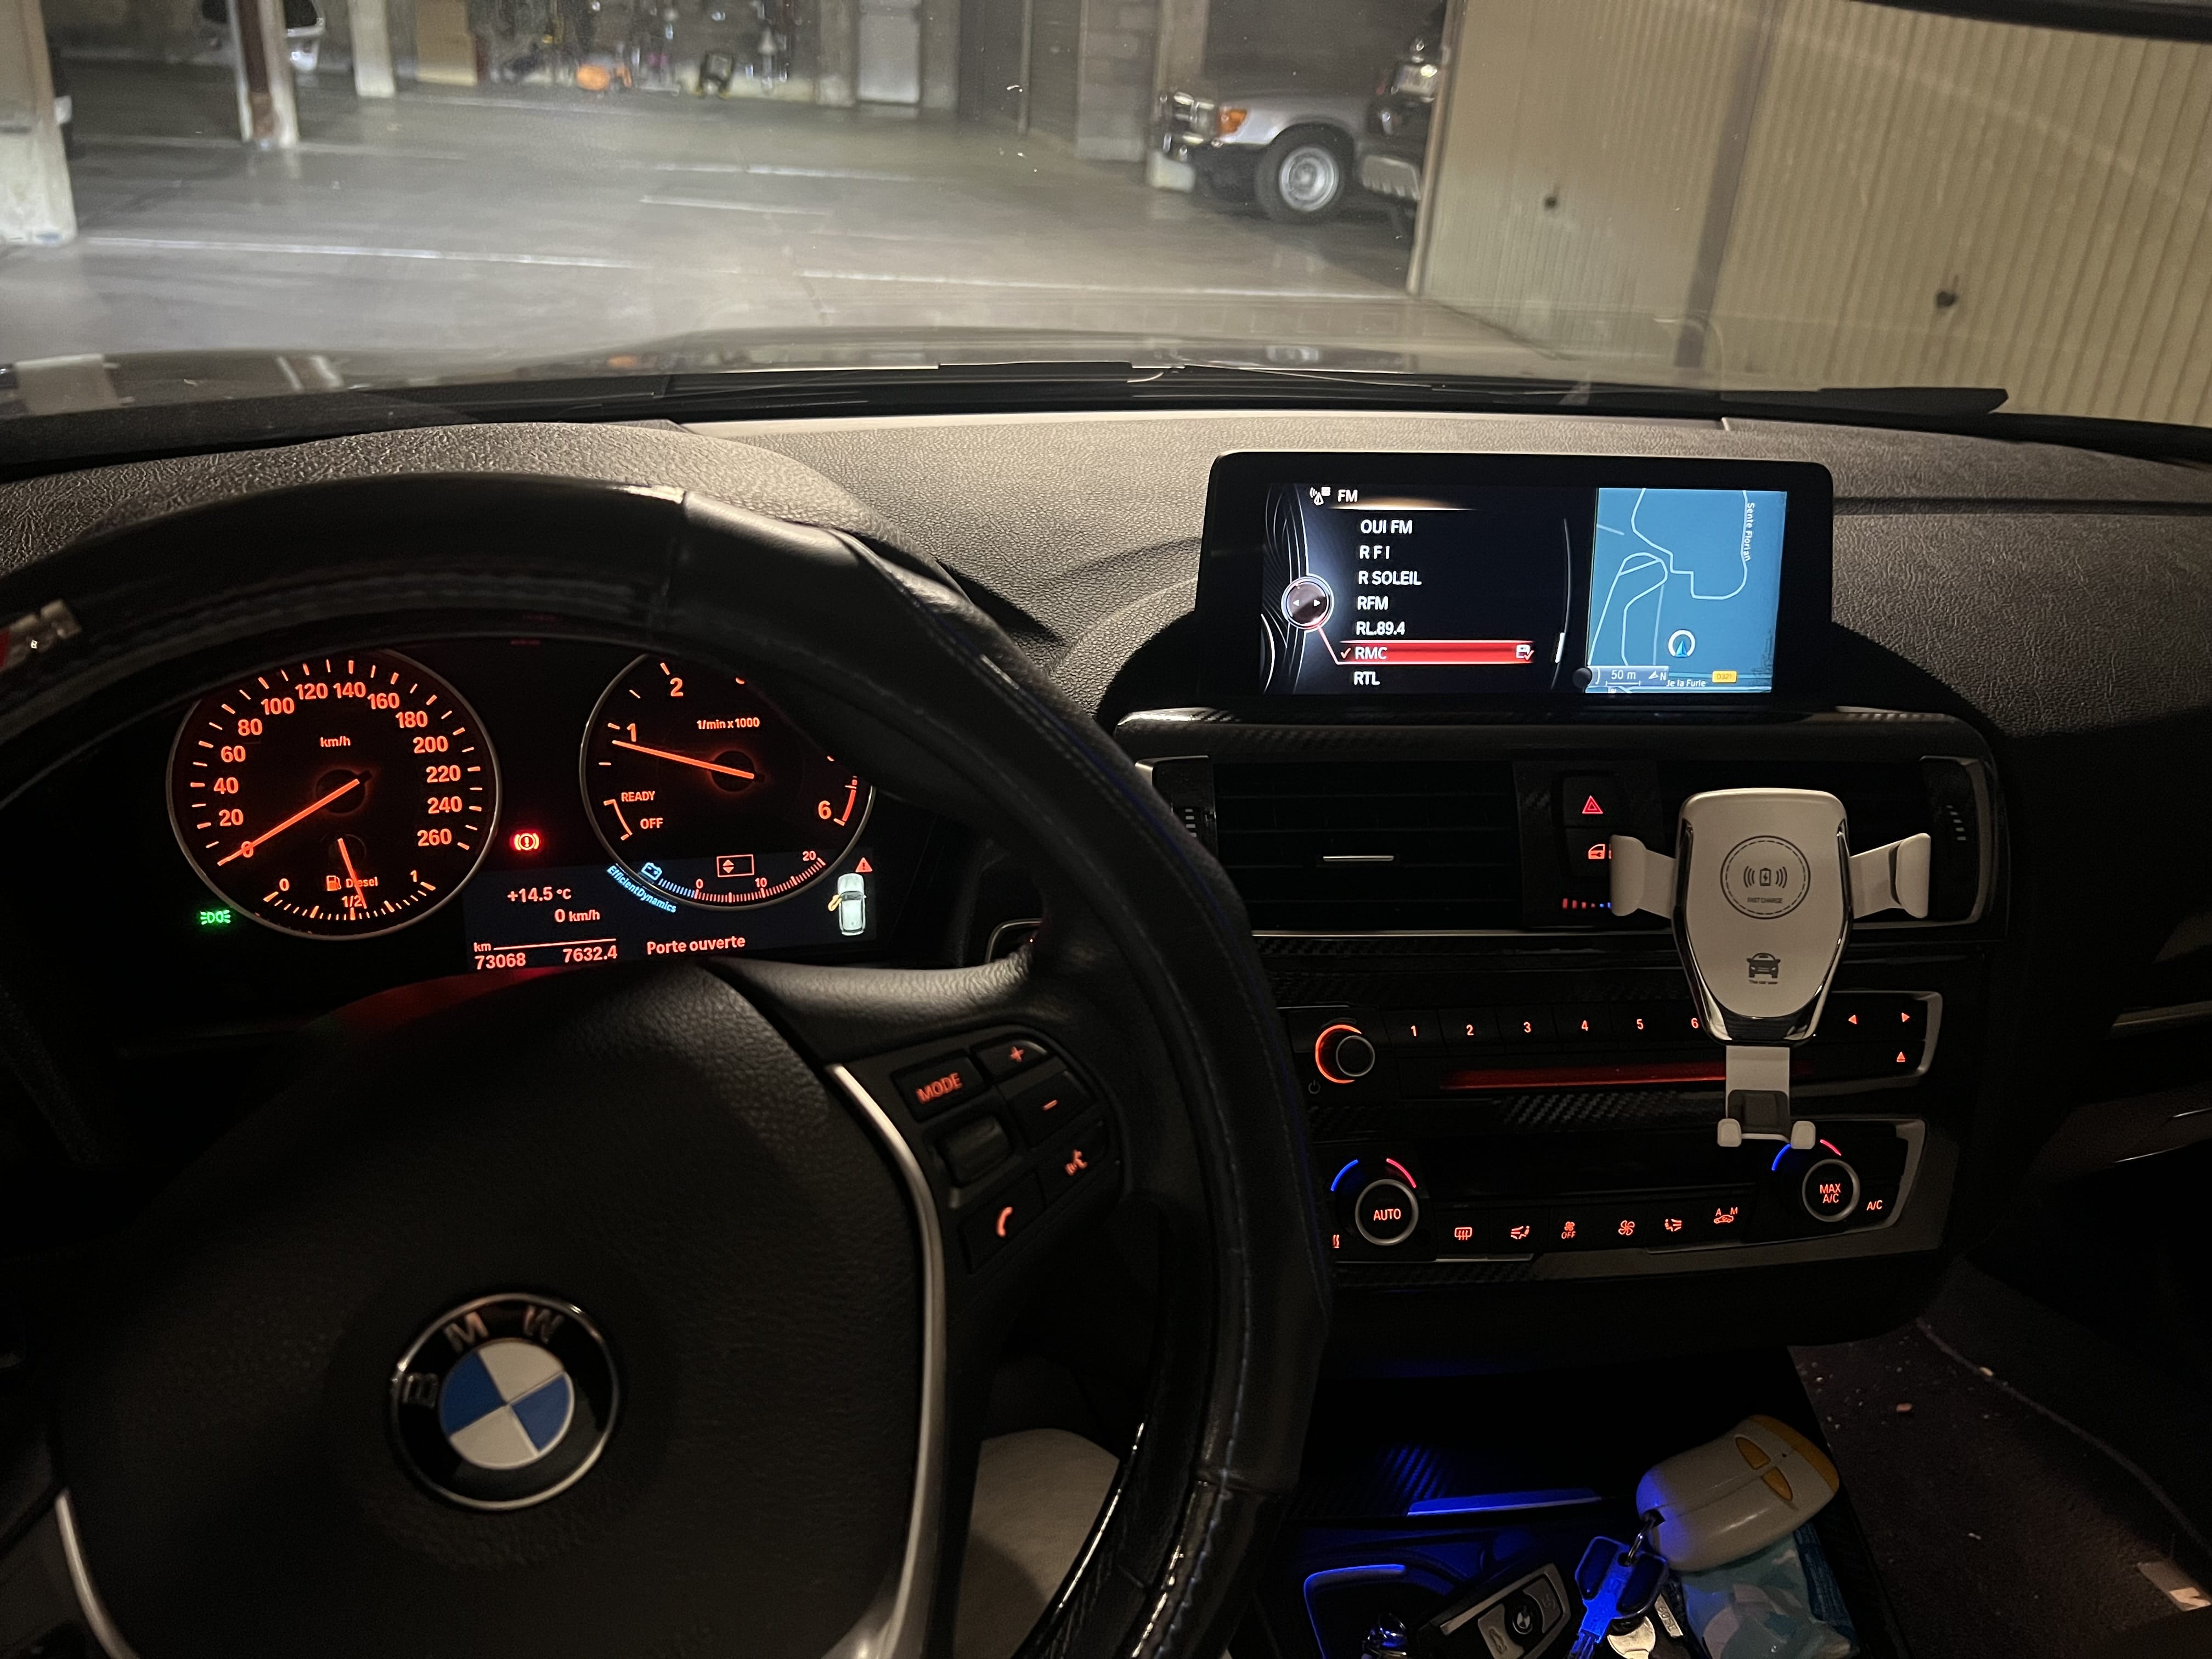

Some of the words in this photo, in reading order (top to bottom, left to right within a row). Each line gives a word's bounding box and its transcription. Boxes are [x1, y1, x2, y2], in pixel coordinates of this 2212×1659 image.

[1338, 489, 1358, 503] FM
[1746, 503, 1755, 528] Sente
[1360, 519, 1387, 534] OUI
[1391, 520, 1413, 534] FM
[1359, 545, 1370, 560] R
[1373, 545, 1383, 560] F
[1743, 530, 1753, 561] Florian
[1358, 570, 1369, 585] R
[1372, 570, 1423, 585] SOLEIL
[1357, 596, 1389, 611] RFM
[1356, 620, 1406, 635] RL.89.4
[1355, 646, 1387, 660] RMC
[1353, 670, 1381, 685] RTL
[1611, 670, 1623, 680] 50
[1627, 672, 1636, 680] m
[1660, 672, 1667, 681] N
[1716, 671, 1733, 680] D321
[295, 682, 328, 700] 120
[332, 681, 367, 699] 140
[670, 677, 684, 697] 2
[260, 697, 296, 715] 100
[367, 692, 399, 710] 160
[396, 710, 428, 729] 180
[696, 719, 726, 730] 1/min
[727, 720, 734, 729] x
[735, 716, 760, 728] 1000
[238, 718, 263, 737] 80
[626, 723, 637, 743] 1
[320, 735, 351, 747] km/h
[413, 735, 449, 754] 200
[220, 745, 246, 763] 60
[426, 764, 461, 783] 220
[213, 776, 240, 794] 40
[620, 791, 656, 803] READY
[427, 795, 462, 815] 240
[817, 800, 832, 820] 6
[218, 808, 244, 827] 20
[640, 817, 663, 830] OFF
[416, 828, 453, 847] 260
[802, 850, 816, 862] 20
[346, 876, 378, 888] Desel
[410, 870, 418, 883] 1
[695, 878, 704, 890] 0
[754, 877, 768, 888] 10
[279, 878, 290, 892] 0
[607, 865, 676, 913] EfficientDynamics
[341, 895, 363, 907] 1/2
[507, 886, 554, 903] +14.5
[554, 909, 566, 923] 0
[568, 909, 600, 922] km/h
[473, 942, 492, 952] km
[646, 940, 687, 955] Porte
[689, 935, 746, 951] ouverte
[474, 952, 527, 970] 73068
[562, 945, 618, 963] 7632.4
[1466, 1024, 1474, 1036] 2
[1523, 1021, 1532, 1033] 3
[1581, 1020, 1589, 1031] 4
[1637, 1018, 1644, 1030] 5
[1691, 1017, 1699, 1029] 6
[1410, 1025, 1417, 1037] 1
[917, 1073, 962, 1102] MODE
[1820, 1183, 1841, 1193] MAX
[1822, 1194, 1839, 1204] A/C
[1866, 1200, 1883, 1211] A/C
[1373, 1208, 1401, 1221] AUTO
